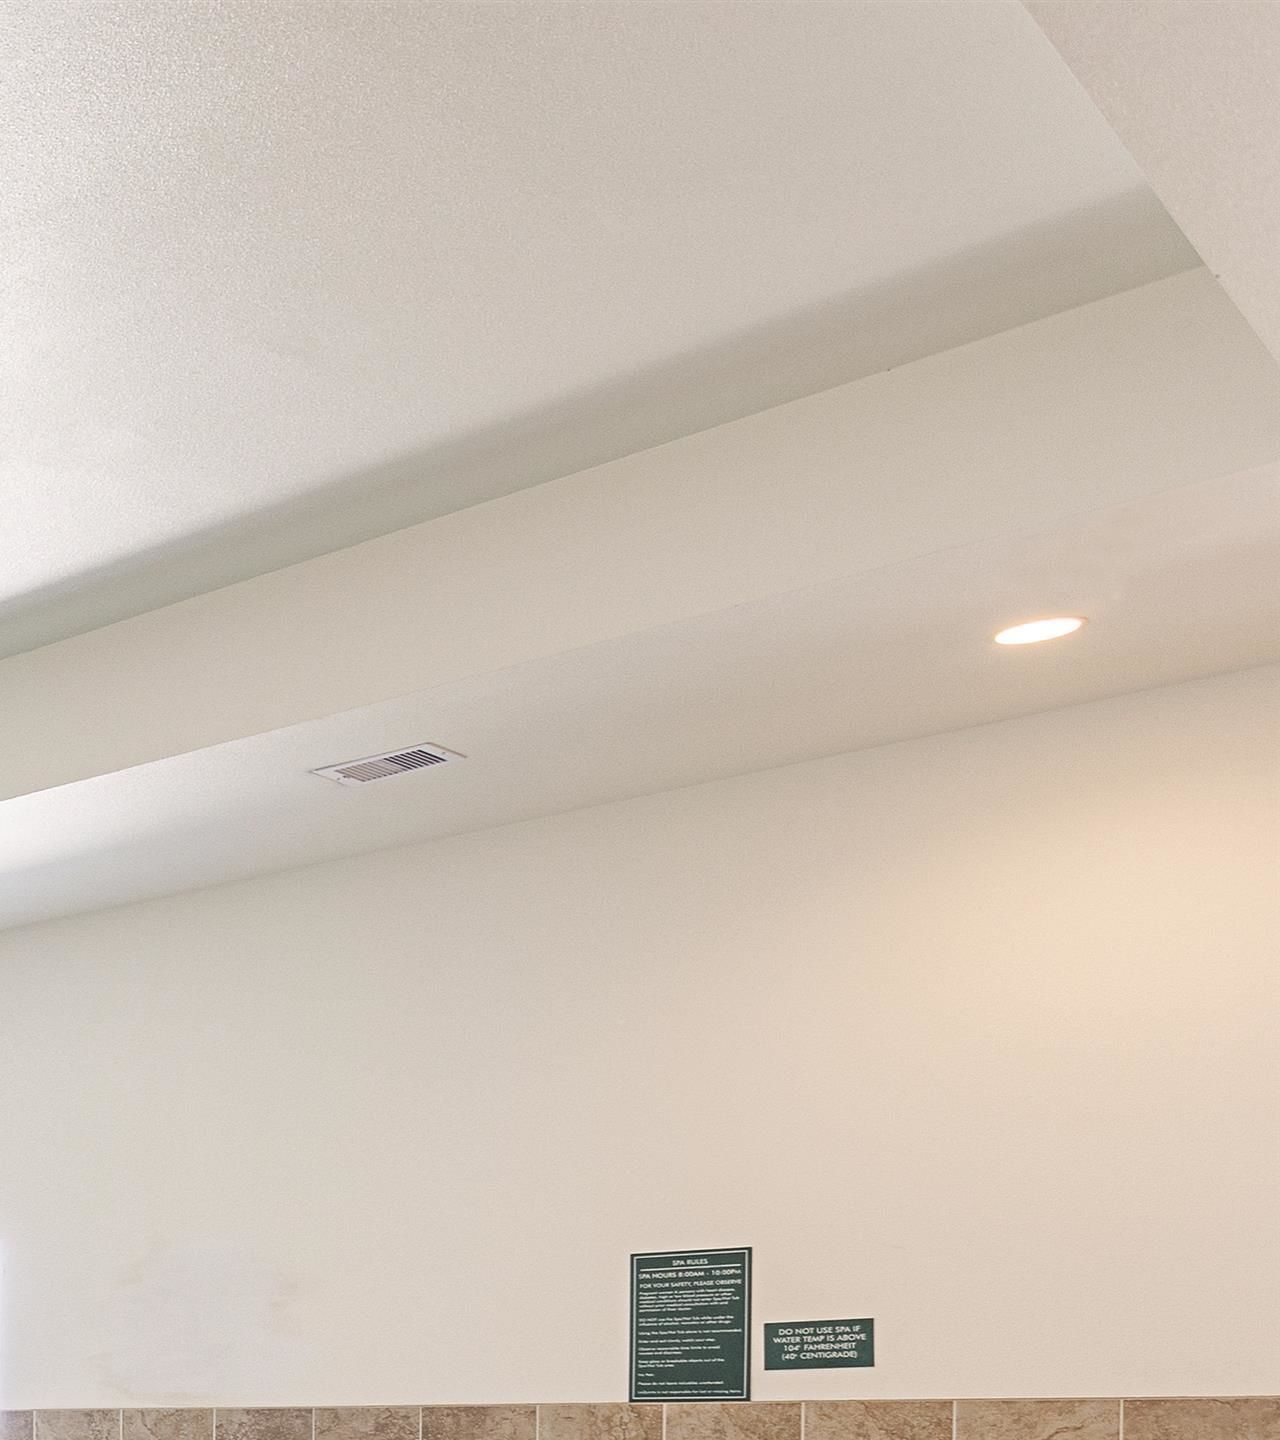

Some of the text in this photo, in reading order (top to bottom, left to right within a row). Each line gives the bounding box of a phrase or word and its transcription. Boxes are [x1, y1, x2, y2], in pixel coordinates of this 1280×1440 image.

[836, 1333, 866, 1341] ABOVE
[803, 1342, 856, 1351] FAHRENHEIT
[800, 1351, 857, 1359] CENTIGRADE)
